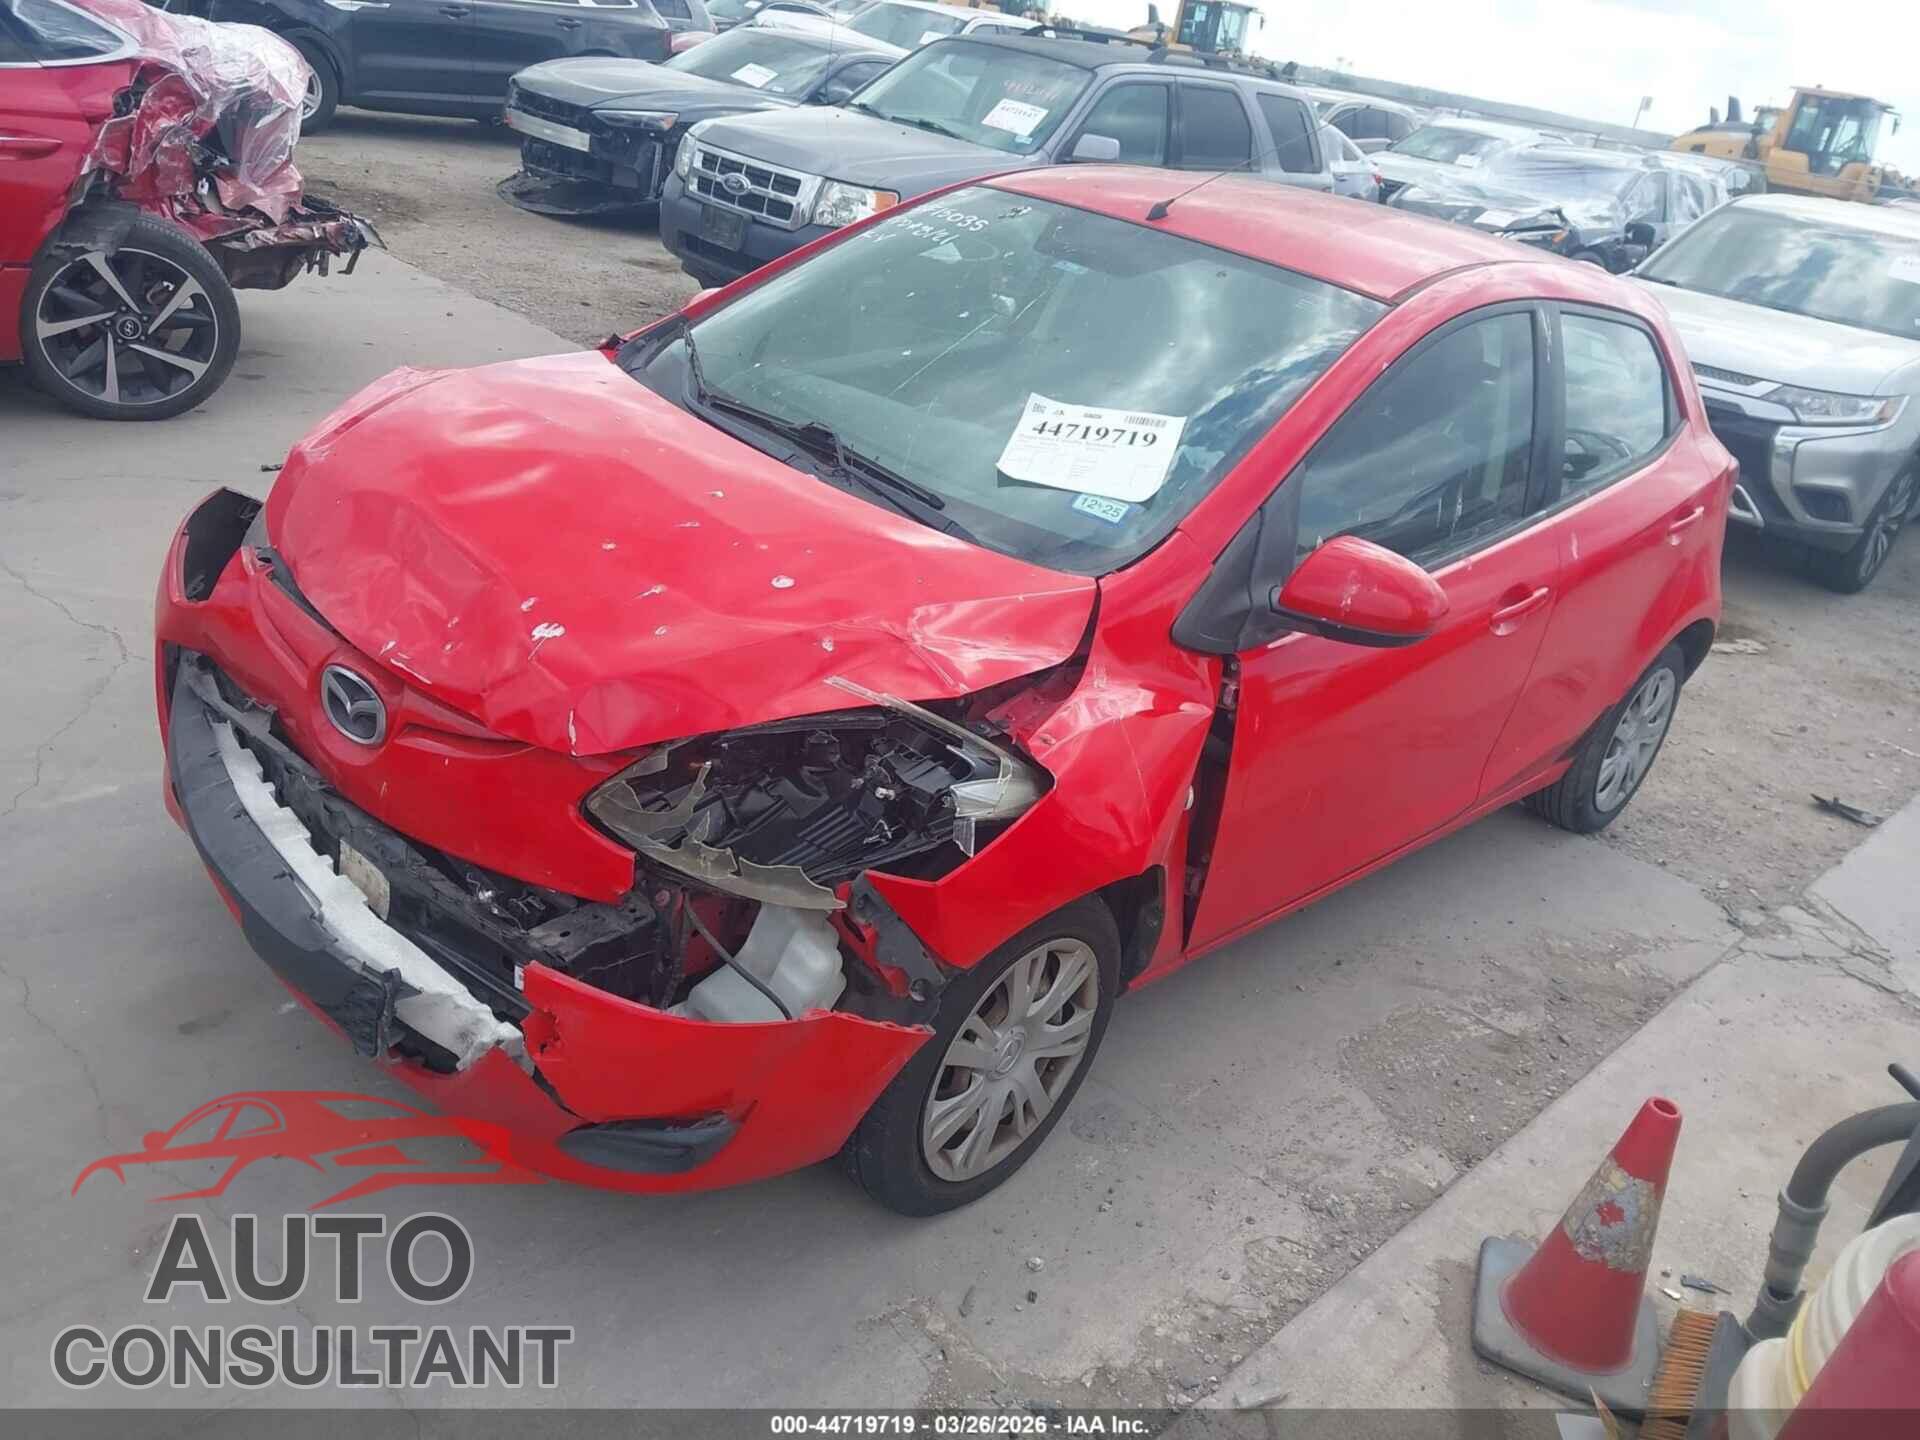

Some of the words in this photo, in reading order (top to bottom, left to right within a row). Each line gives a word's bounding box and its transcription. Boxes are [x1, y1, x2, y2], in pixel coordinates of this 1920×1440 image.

[1032, 421, 1157, 447] 44719719
[1081, 497, 1098, 509] 12
[1102, 504, 1122, 517] 25
